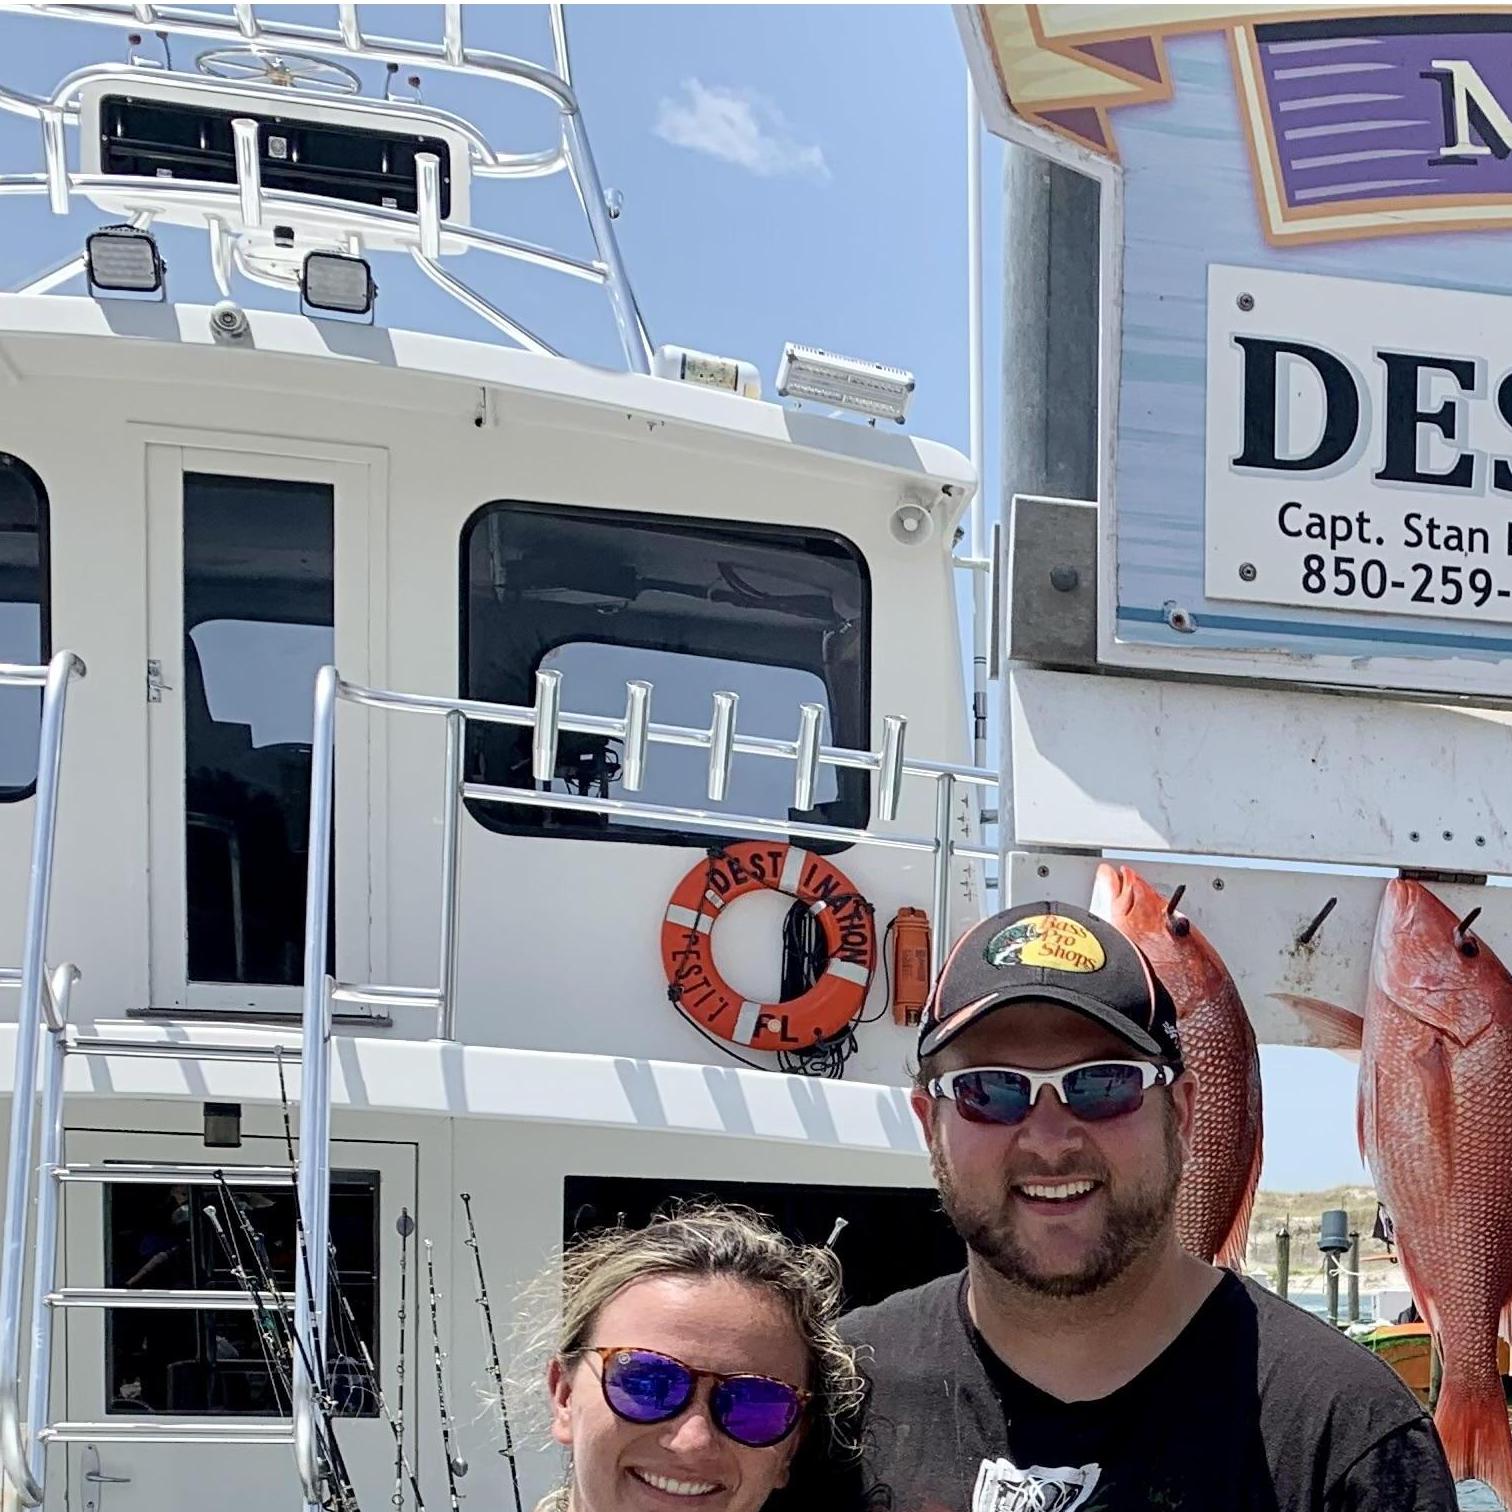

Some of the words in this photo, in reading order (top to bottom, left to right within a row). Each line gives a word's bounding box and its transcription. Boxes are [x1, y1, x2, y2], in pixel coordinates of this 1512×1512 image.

[1279, 502, 1385, 550] Capt.
[1403, 513, 1491, 556] Stan
[1041, 915, 1088, 939] Bass
[1041, 930, 1076, 946] Pro
[1039, 944, 1097, 970] Shops
